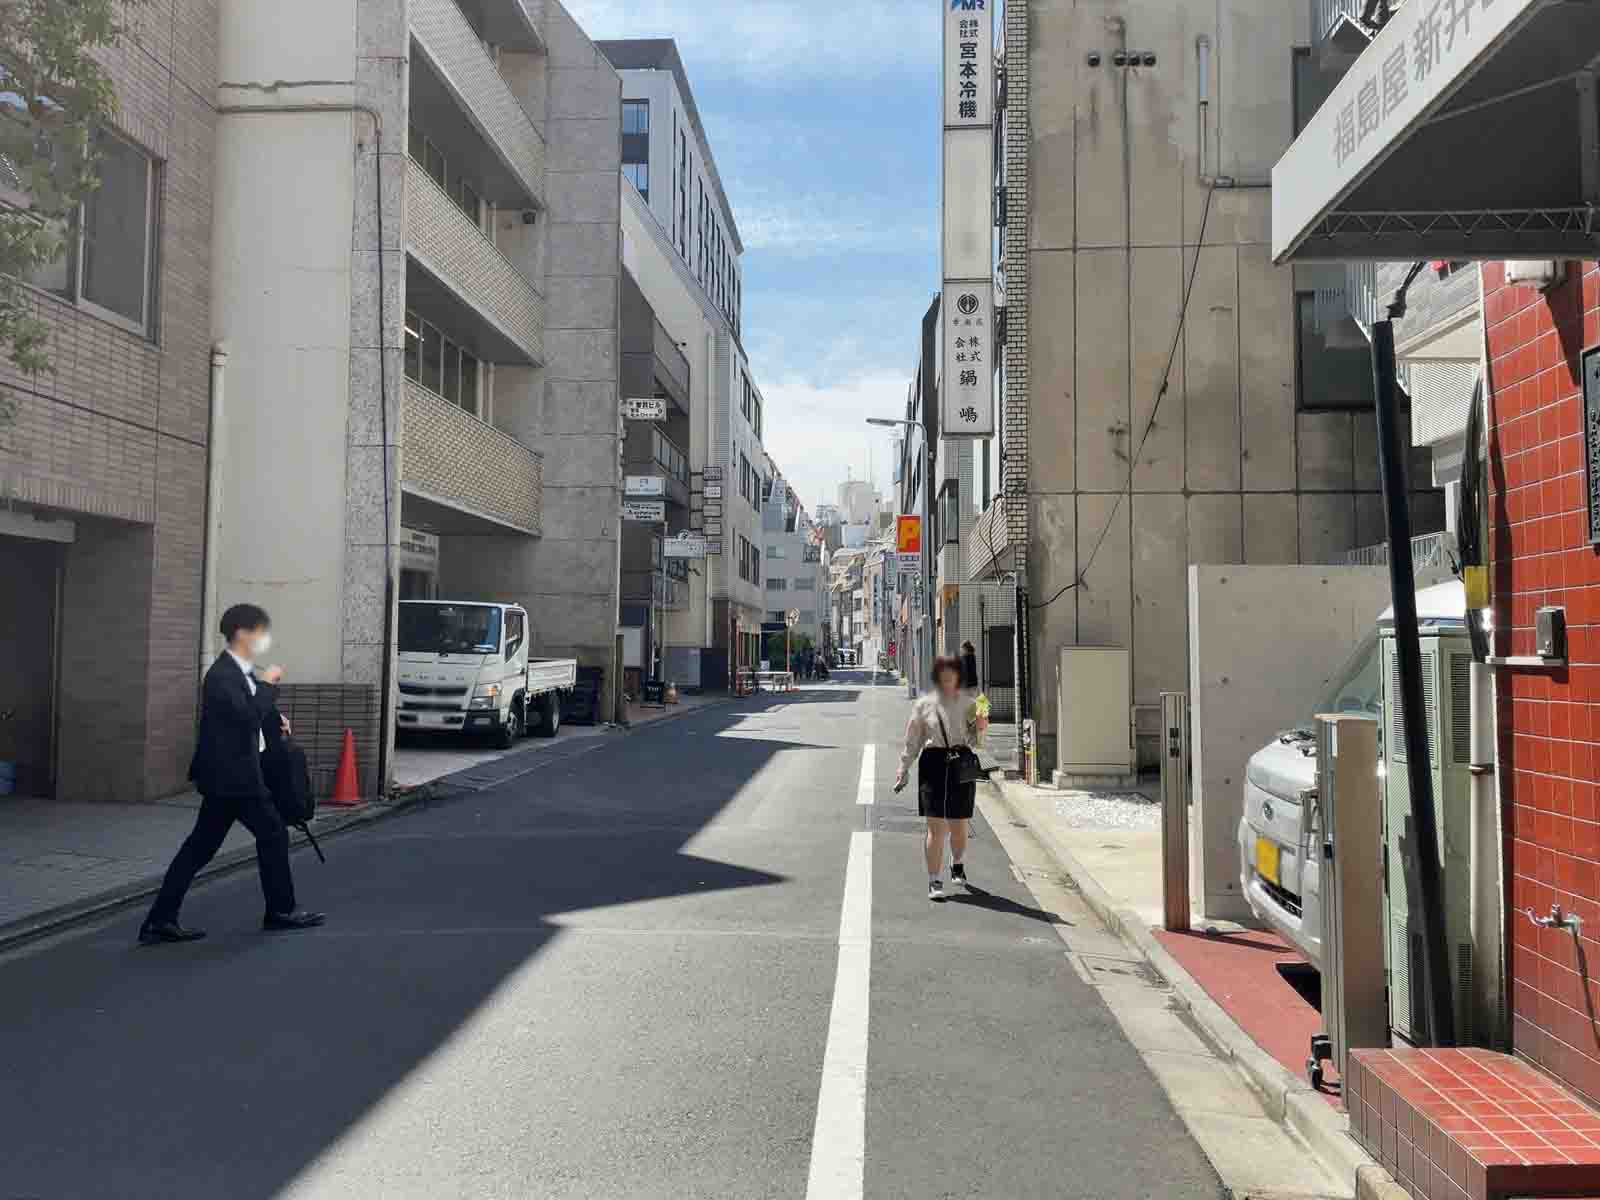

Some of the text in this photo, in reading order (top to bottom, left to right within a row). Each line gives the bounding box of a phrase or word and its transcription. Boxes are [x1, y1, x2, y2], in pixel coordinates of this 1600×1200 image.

[959, 42, 977, 118] 宮本冷機
[1332, 0, 1495, 168] 福島屋新井
